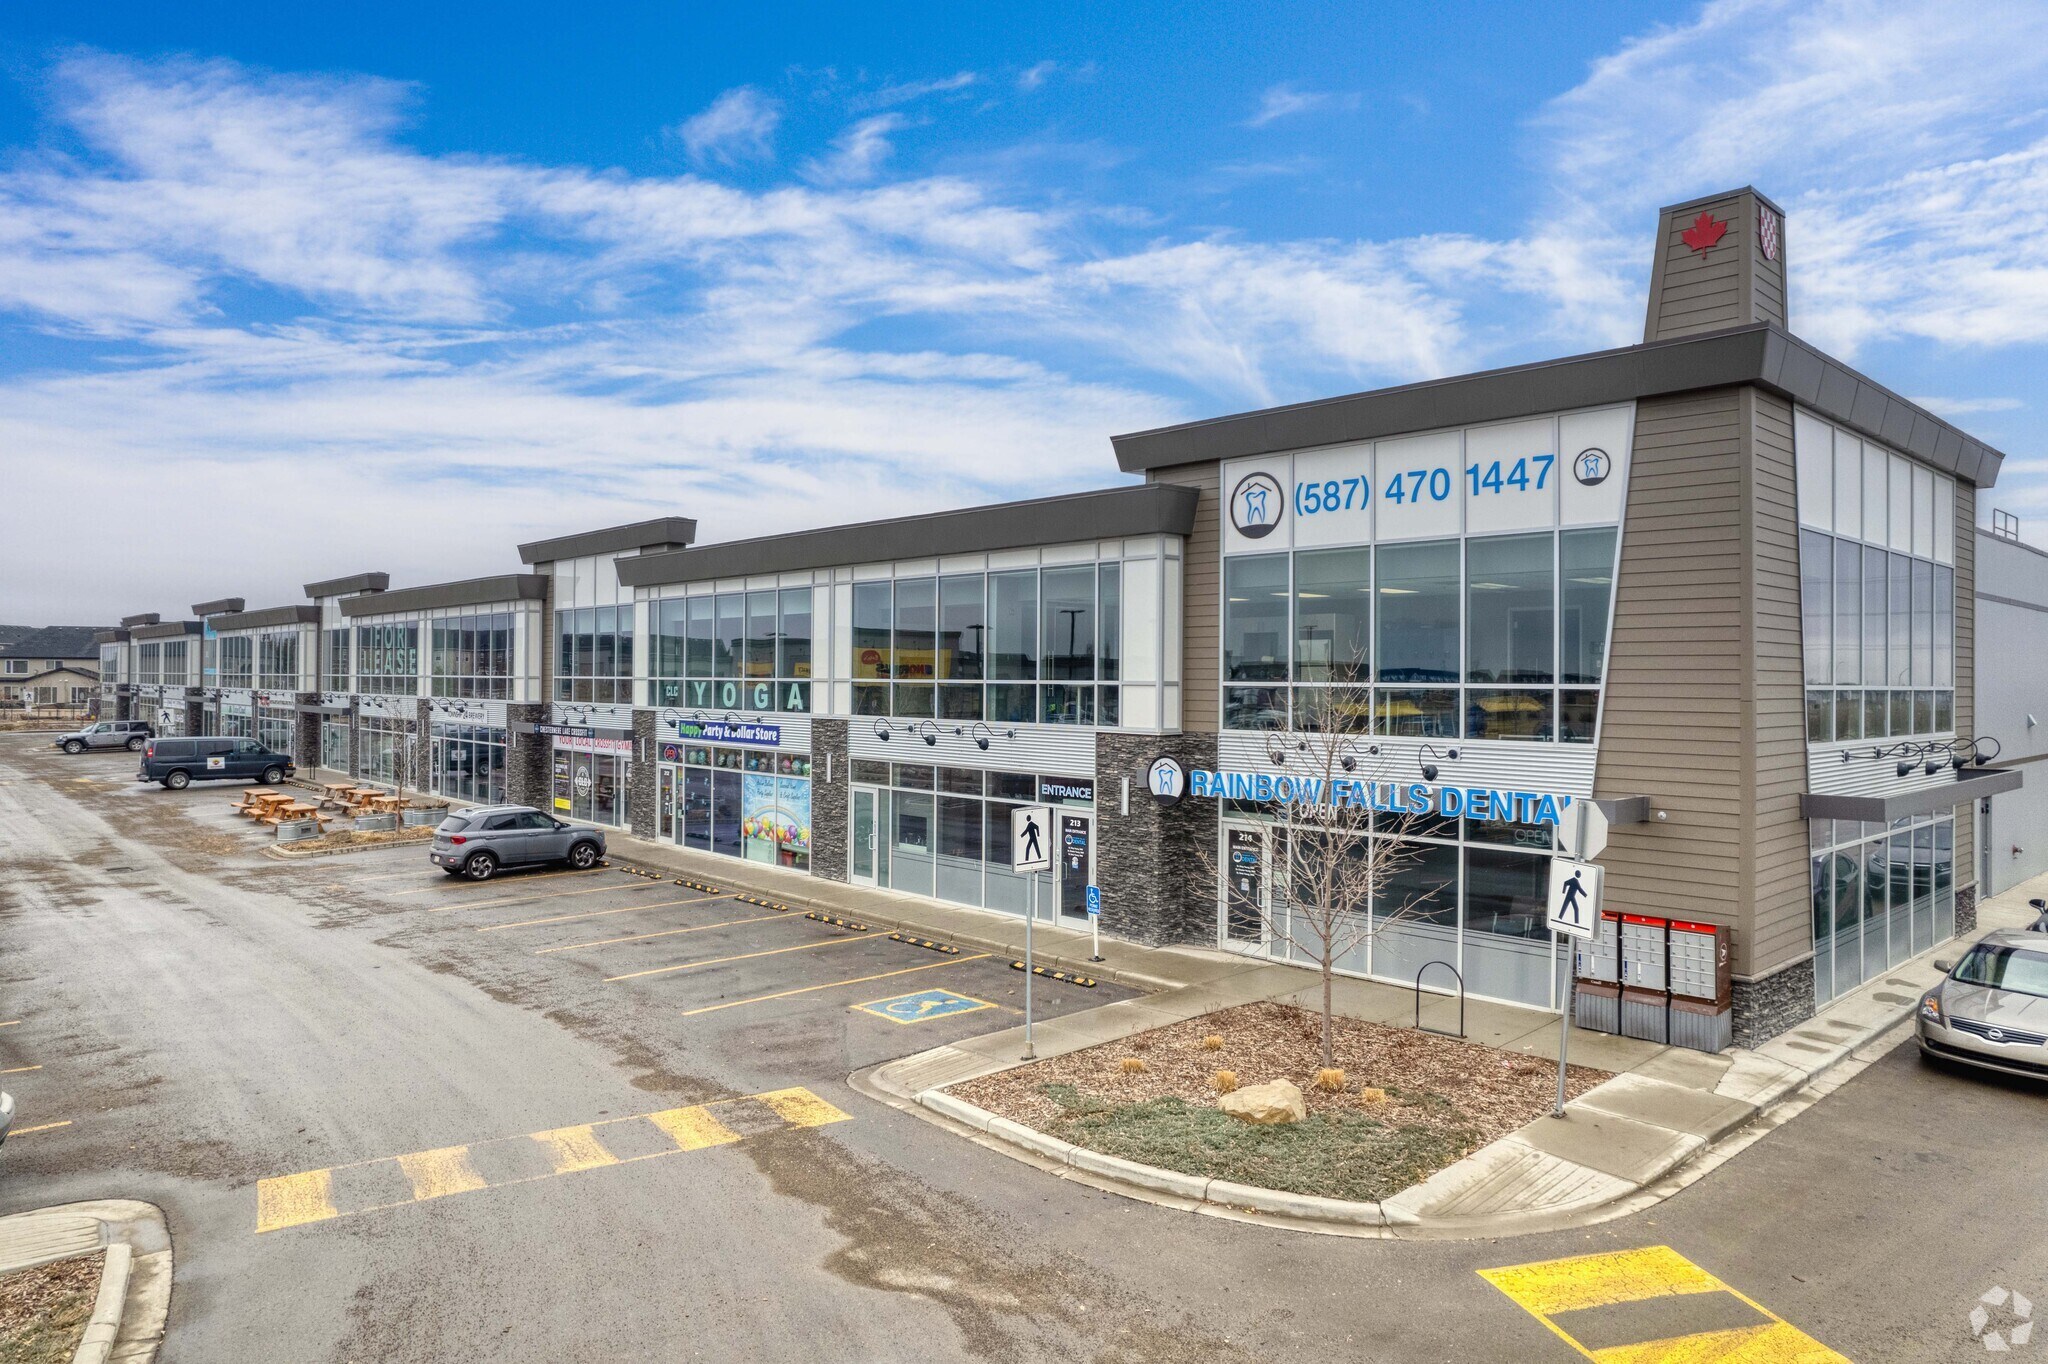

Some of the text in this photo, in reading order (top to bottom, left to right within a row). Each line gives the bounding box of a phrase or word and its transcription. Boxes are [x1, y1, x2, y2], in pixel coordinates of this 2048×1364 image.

[1295, 454, 1554, 516] (587) 470 1447
[374, 623, 405, 650] FOR
[361, 648, 417, 674] LEASE
[665, 685, 679, 697] CLC
[693, 681, 804, 710] YOGA
[540, 725, 588, 737] CHESTERMERE LAKE CROSSFIT
[680, 722, 702, 738] Happy
[703, 724, 723, 740] Party
[723, 726, 731, 738] &
[755, 728, 778, 741] Store
[559, 735, 573, 745] YOUR
[575, 737, 592, 747] LOCAL
[594, 738, 615, 749] CROSSFIT
[1041, 783, 1092, 799] ENTRANCE
[1191, 769, 1572, 827] RAINBOW FALLS DENTA
[1299, 803, 1338, 821] OPEN
[1069, 819, 1081, 827] 213
[1238, 833, 1253, 842] 214
[1514, 828, 1552, 844] OPEN
